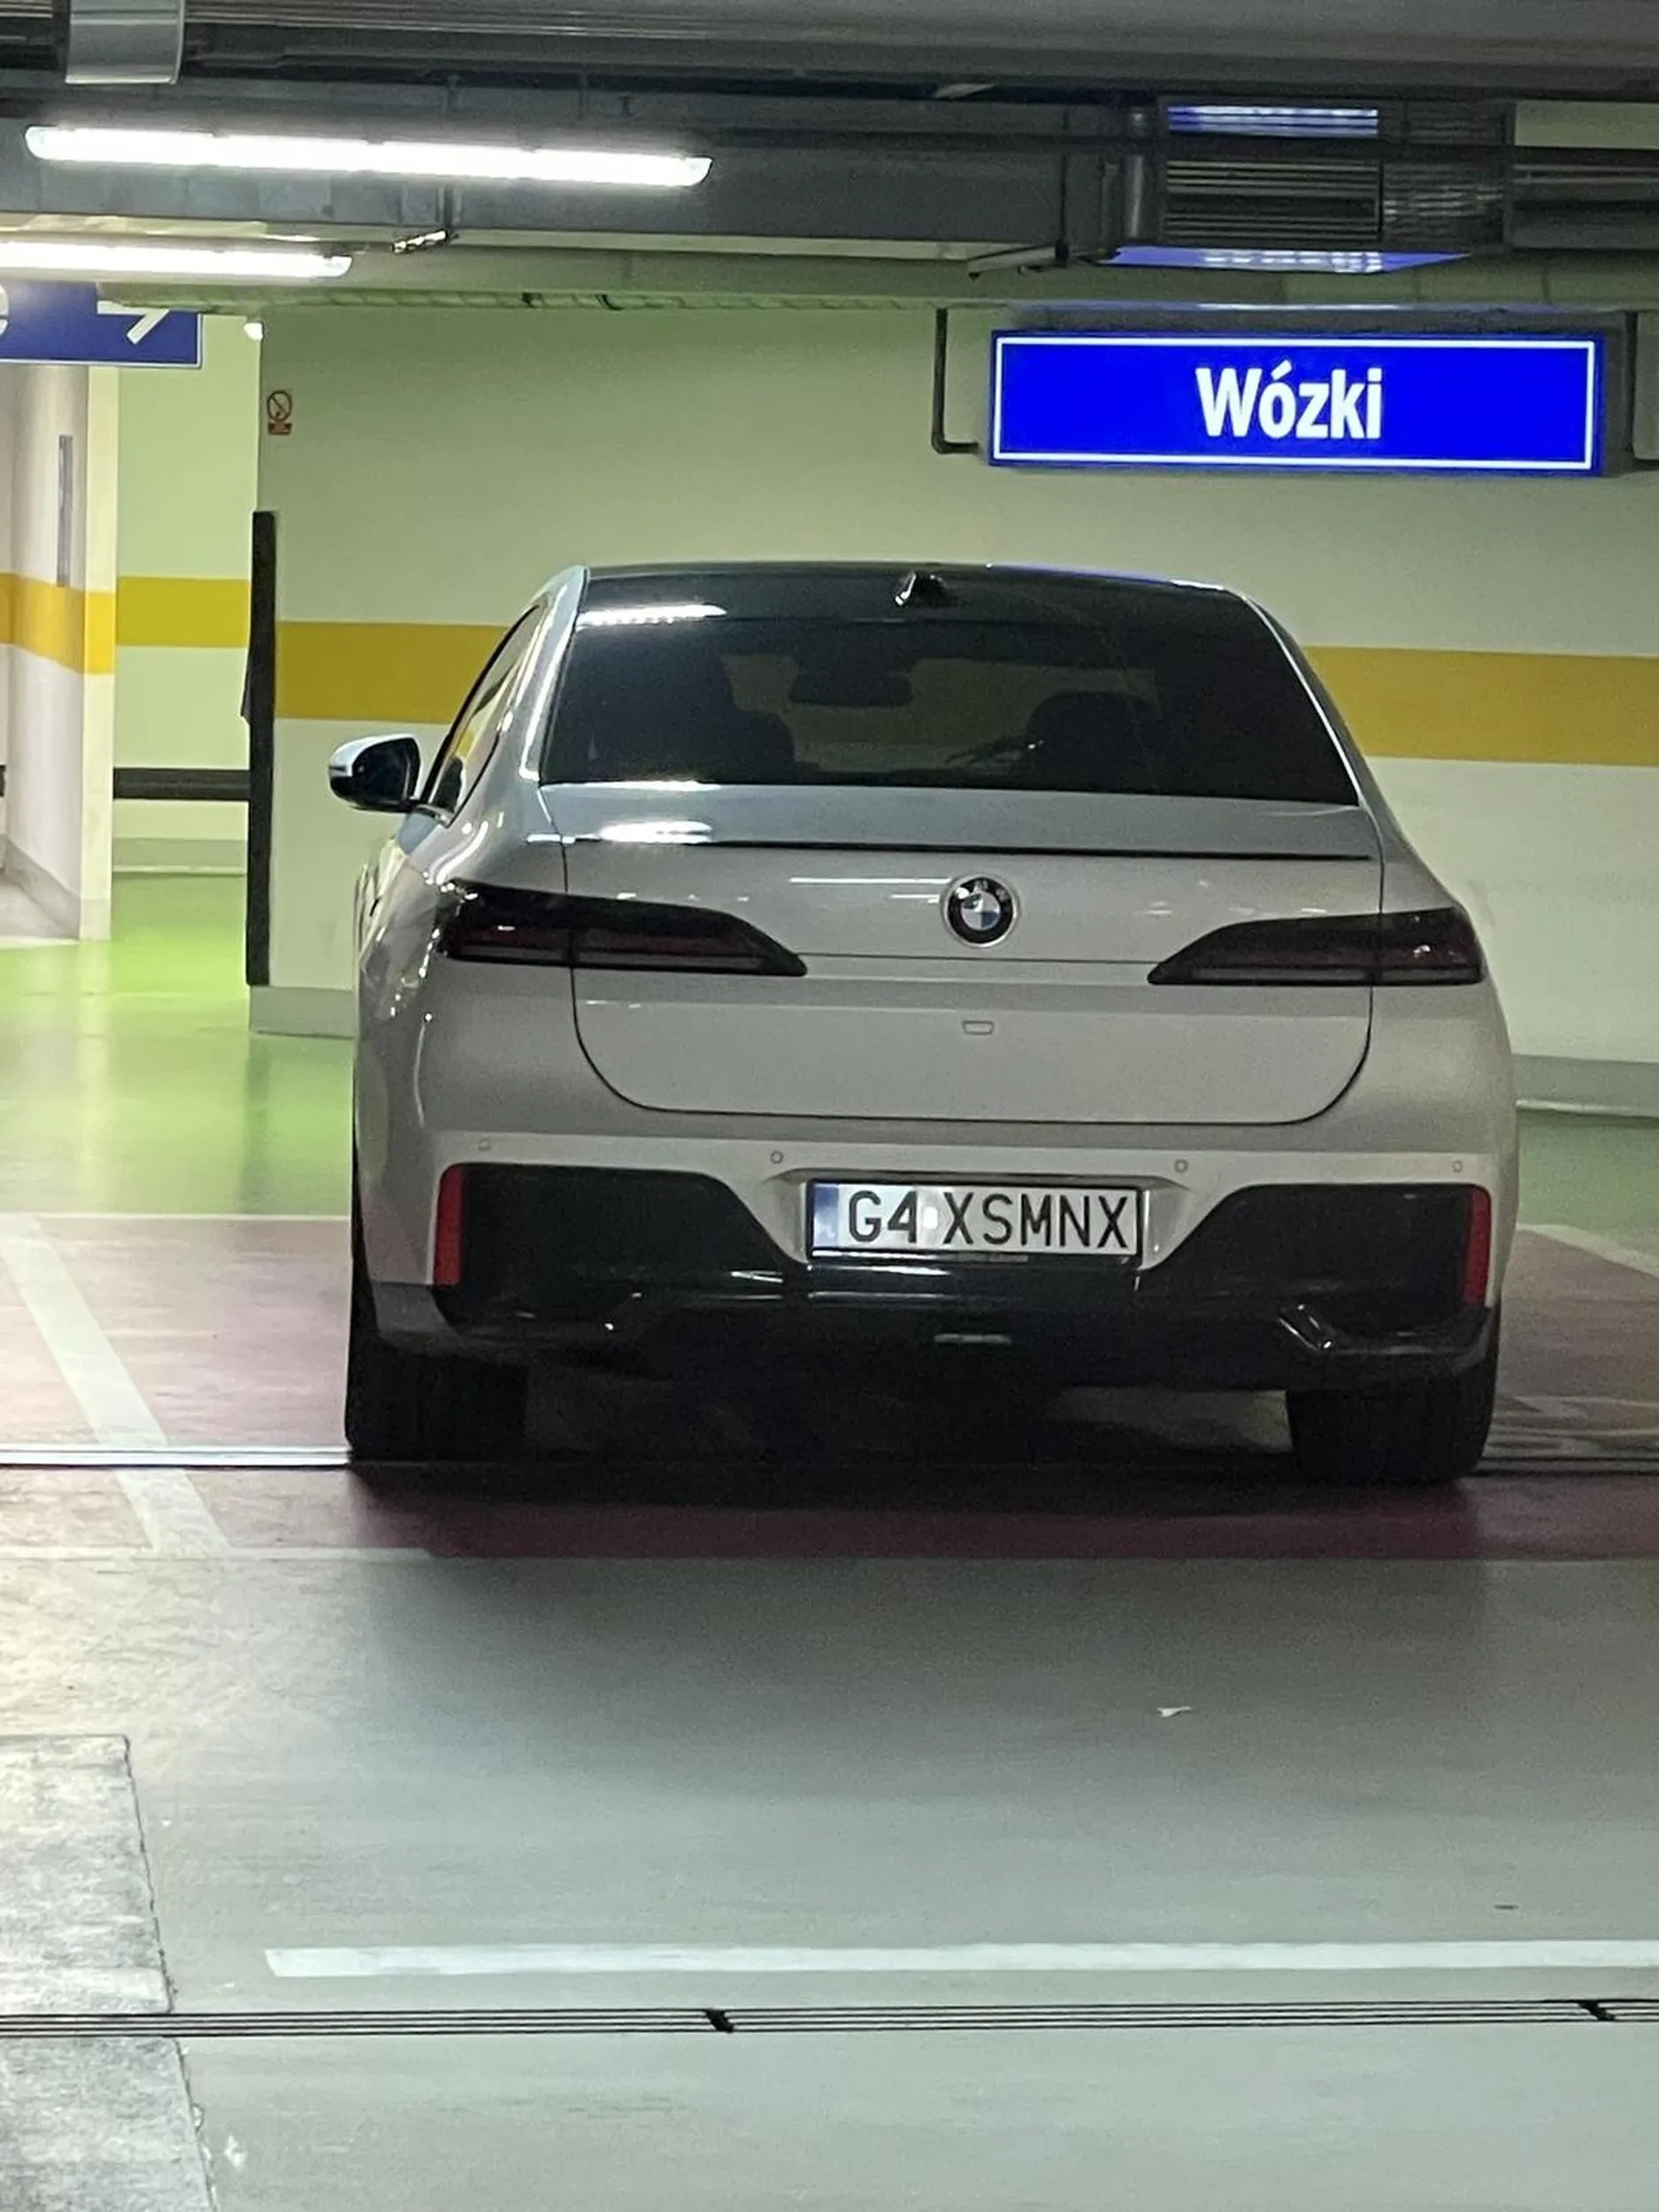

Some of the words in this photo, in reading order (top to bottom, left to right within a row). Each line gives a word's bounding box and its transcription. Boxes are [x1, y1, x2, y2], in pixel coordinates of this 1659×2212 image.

[1195, 359, 1384, 440] Wózki
[849, 1191, 918, 1243] G4
[943, 1192, 1129, 1248] XSMNX
